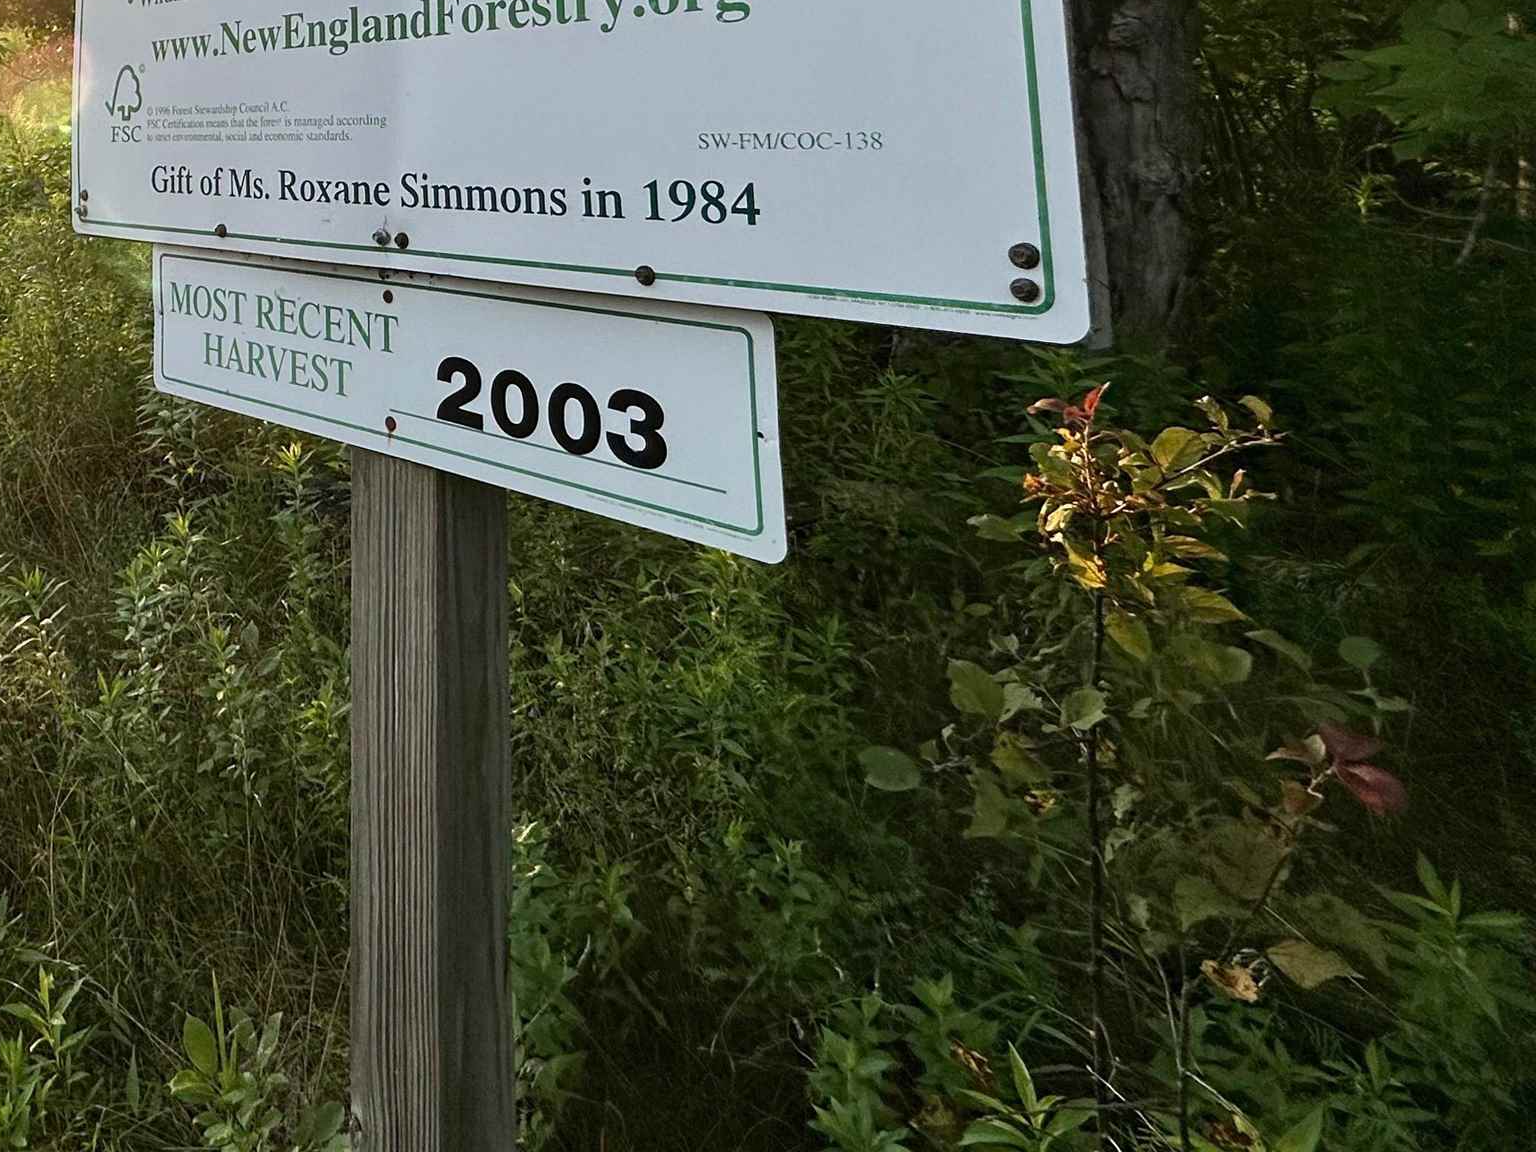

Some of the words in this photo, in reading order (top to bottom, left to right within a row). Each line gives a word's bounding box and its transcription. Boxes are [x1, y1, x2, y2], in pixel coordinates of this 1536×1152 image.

[239, 103, 269, 113] Council
[162, 119, 204, 128] Certification
[284, 116, 292, 127] is
[294, 114, 334, 129] managed
[336, 114, 386, 128] according
[111, 126, 141, 142] FSC
[265, 129, 302, 141] economic
[306, 129, 352, 141] standards.
[699, 132, 882, 150] SW-FM/COC-138
[152, 166, 192, 194] Gift
[200, 168, 223, 196] of
[229, 169, 269, 199] Ms.
[279, 170, 390, 206] Roxane
[401, 173, 566, 216] Simmons
[582, 178, 625, 218] in
[643, 180, 760, 225] 1984
[171, 282, 247, 325] MOST
[256, 295, 398, 353] RECENT
[204, 332, 352, 396] HARVEST
[437, 357, 667, 469] 2003
